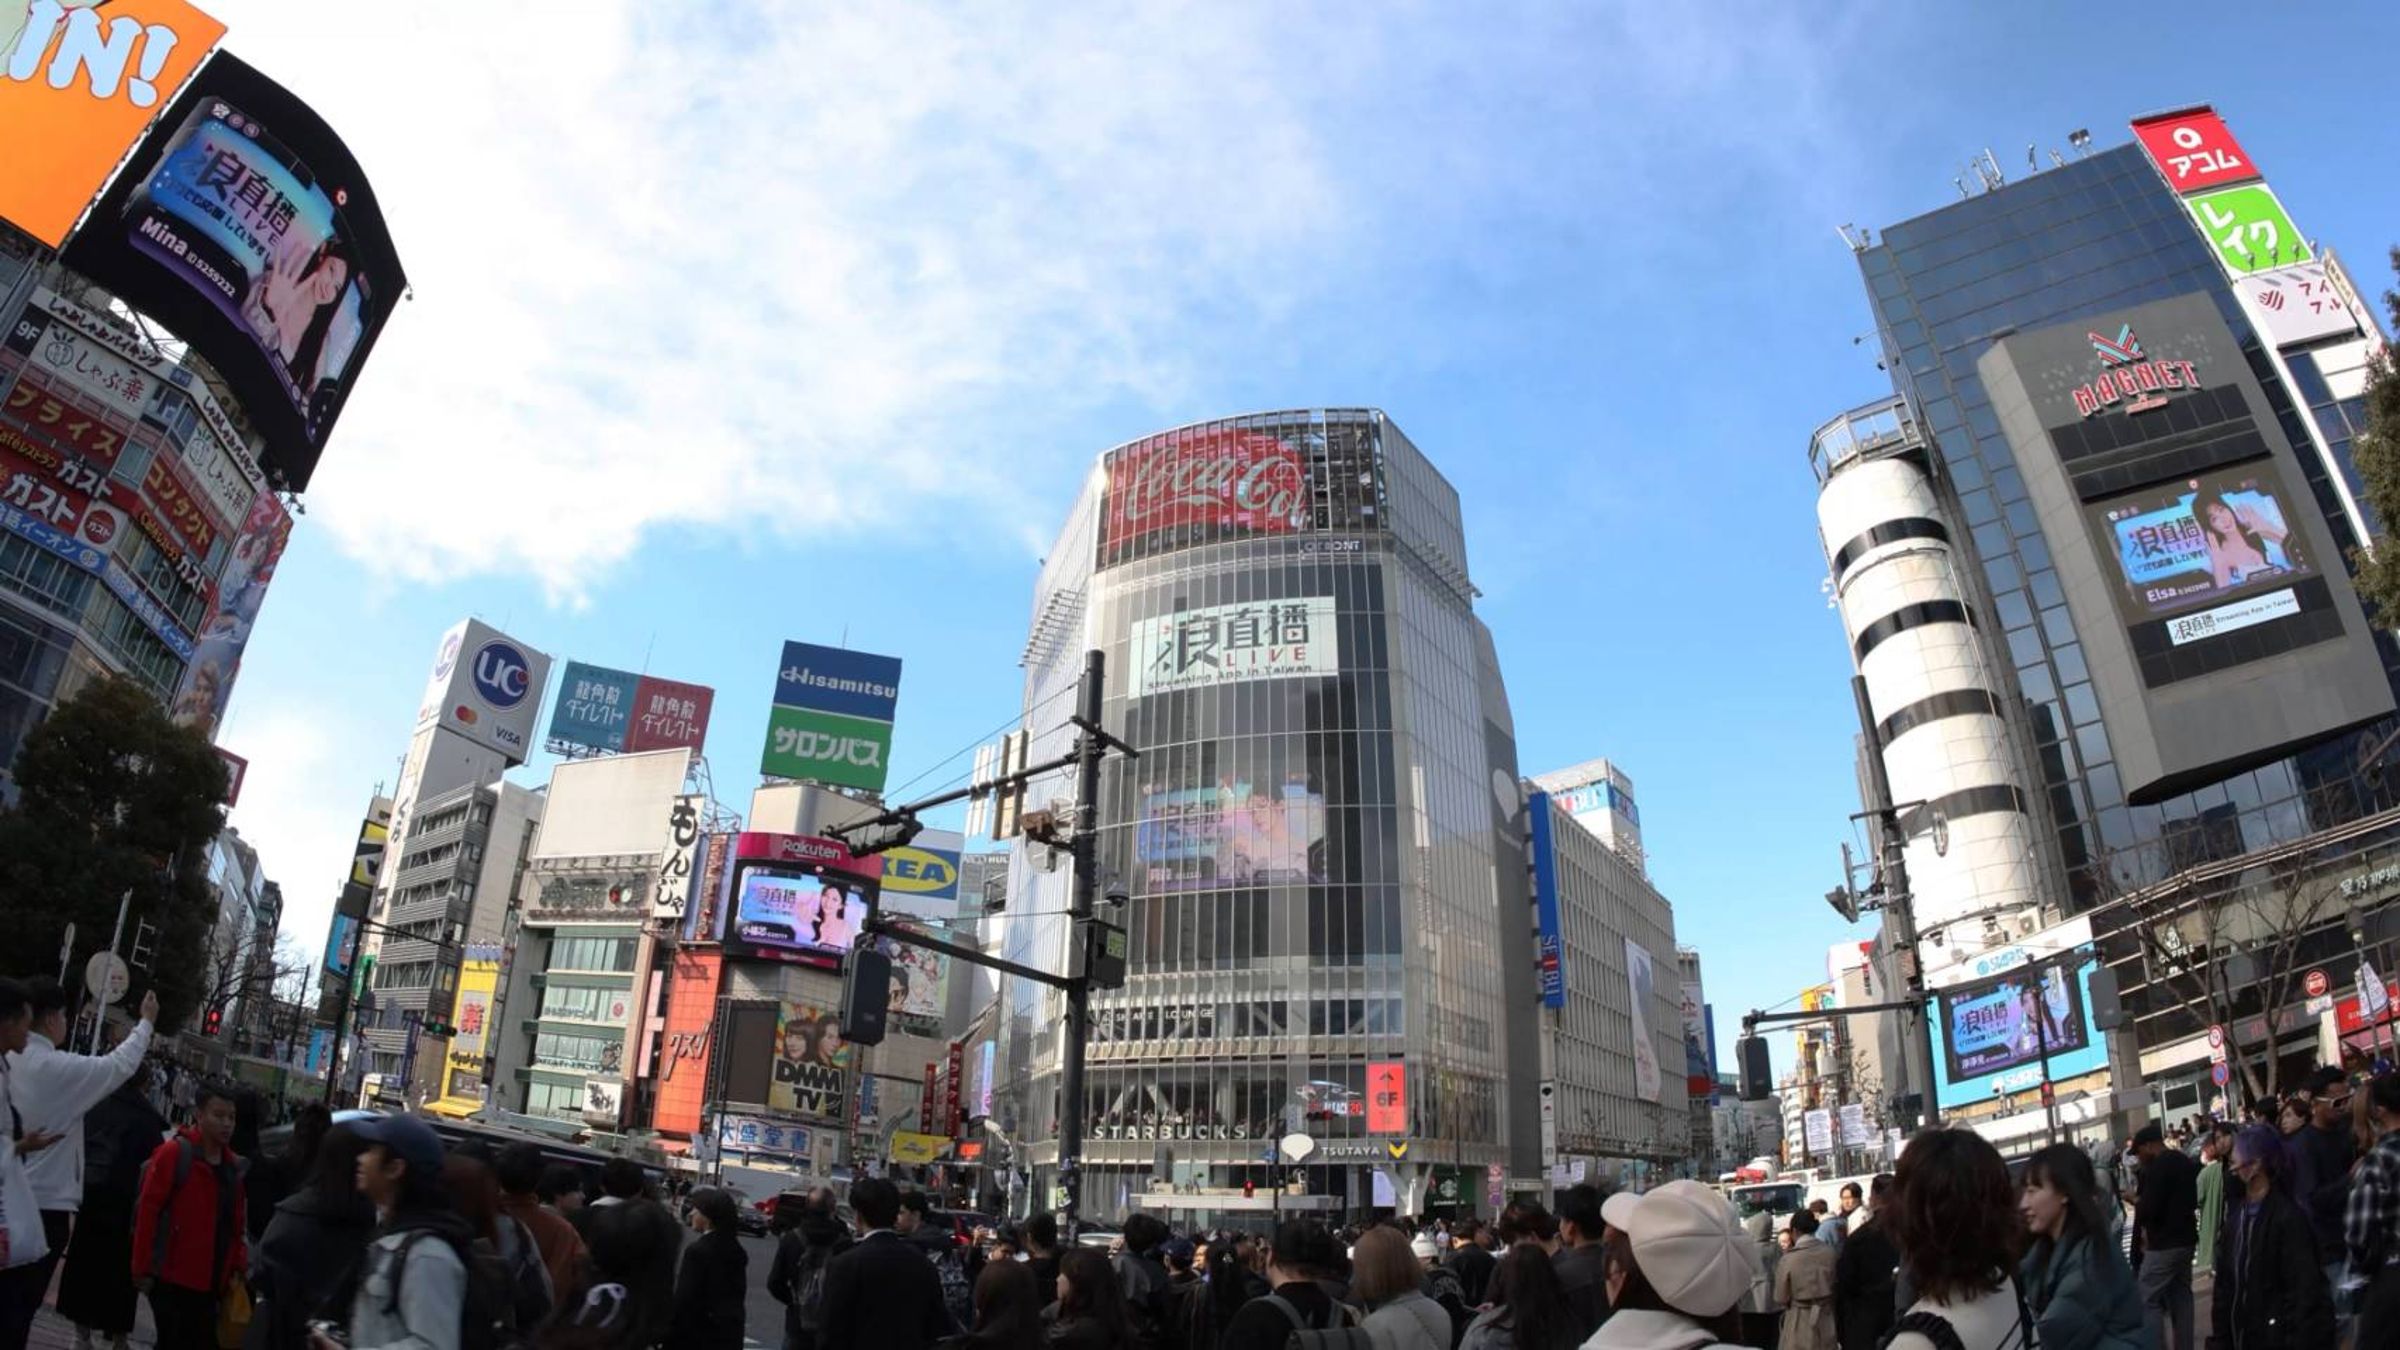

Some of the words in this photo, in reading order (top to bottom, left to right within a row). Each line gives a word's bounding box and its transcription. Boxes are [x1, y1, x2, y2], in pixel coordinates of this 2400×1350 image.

[2167, 148, 2242, 178] アコム
[229, 197, 280, 247] LIVE
[2200, 202, 2279, 256] レイク
[141, 216, 188, 257] Mina
[185, 251, 198, 265] ID
[15, 320, 40, 340] 9F
[76, 350, 145, 402] しゃぶ葉
[2072, 359, 2201, 417] MAGNET
[56, 458, 113, 499] ガスト
[1126, 448, 1311, 531] Coca-Col
[3, 471, 76, 526] ガスト
[149, 461, 209, 547] コンタクト
[87, 520, 112, 538] ガスト
[2128, 515, 2201, 561] 浪直播
[176, 554, 208, 594] ガスト
[2146, 585, 2178, 602] Elsa
[1149, 603, 1310, 677] 浪直播
[2173, 613, 2215, 640] 浪直播
[1226, 646, 1307, 668] LIVE
[781, 665, 896, 699] Hisamitsu
[1147, 673, 1213, 690] Streaming
[1217, 669, 1243, 682] App
[1246, 667, 1259, 677] in
[1264, 664, 1312, 675] Taiwan
[566, 700, 624, 725] ダイレクト
[641, 713, 699, 741] ダイレクト
[496, 725, 521, 747] VISA
[774, 725, 881, 768] サロンパス
[656, 797, 698, 915] もんじゃ
[782, 839, 841, 859] Rakuten
[1542, 934, 1561, 996] SEIBU
[1165, 1008, 1216, 1020] LOUNGE
[1958, 1001, 2009, 1036] 浪直播
[774, 1059, 841, 1093] DMM
[793, 1087, 822, 1112] TV
[1376, 1091, 1398, 1107] 6F
[1094, 1125, 1246, 1140] STARBUCKS
[1321, 1146, 1380, 1156] TSUTAYA
